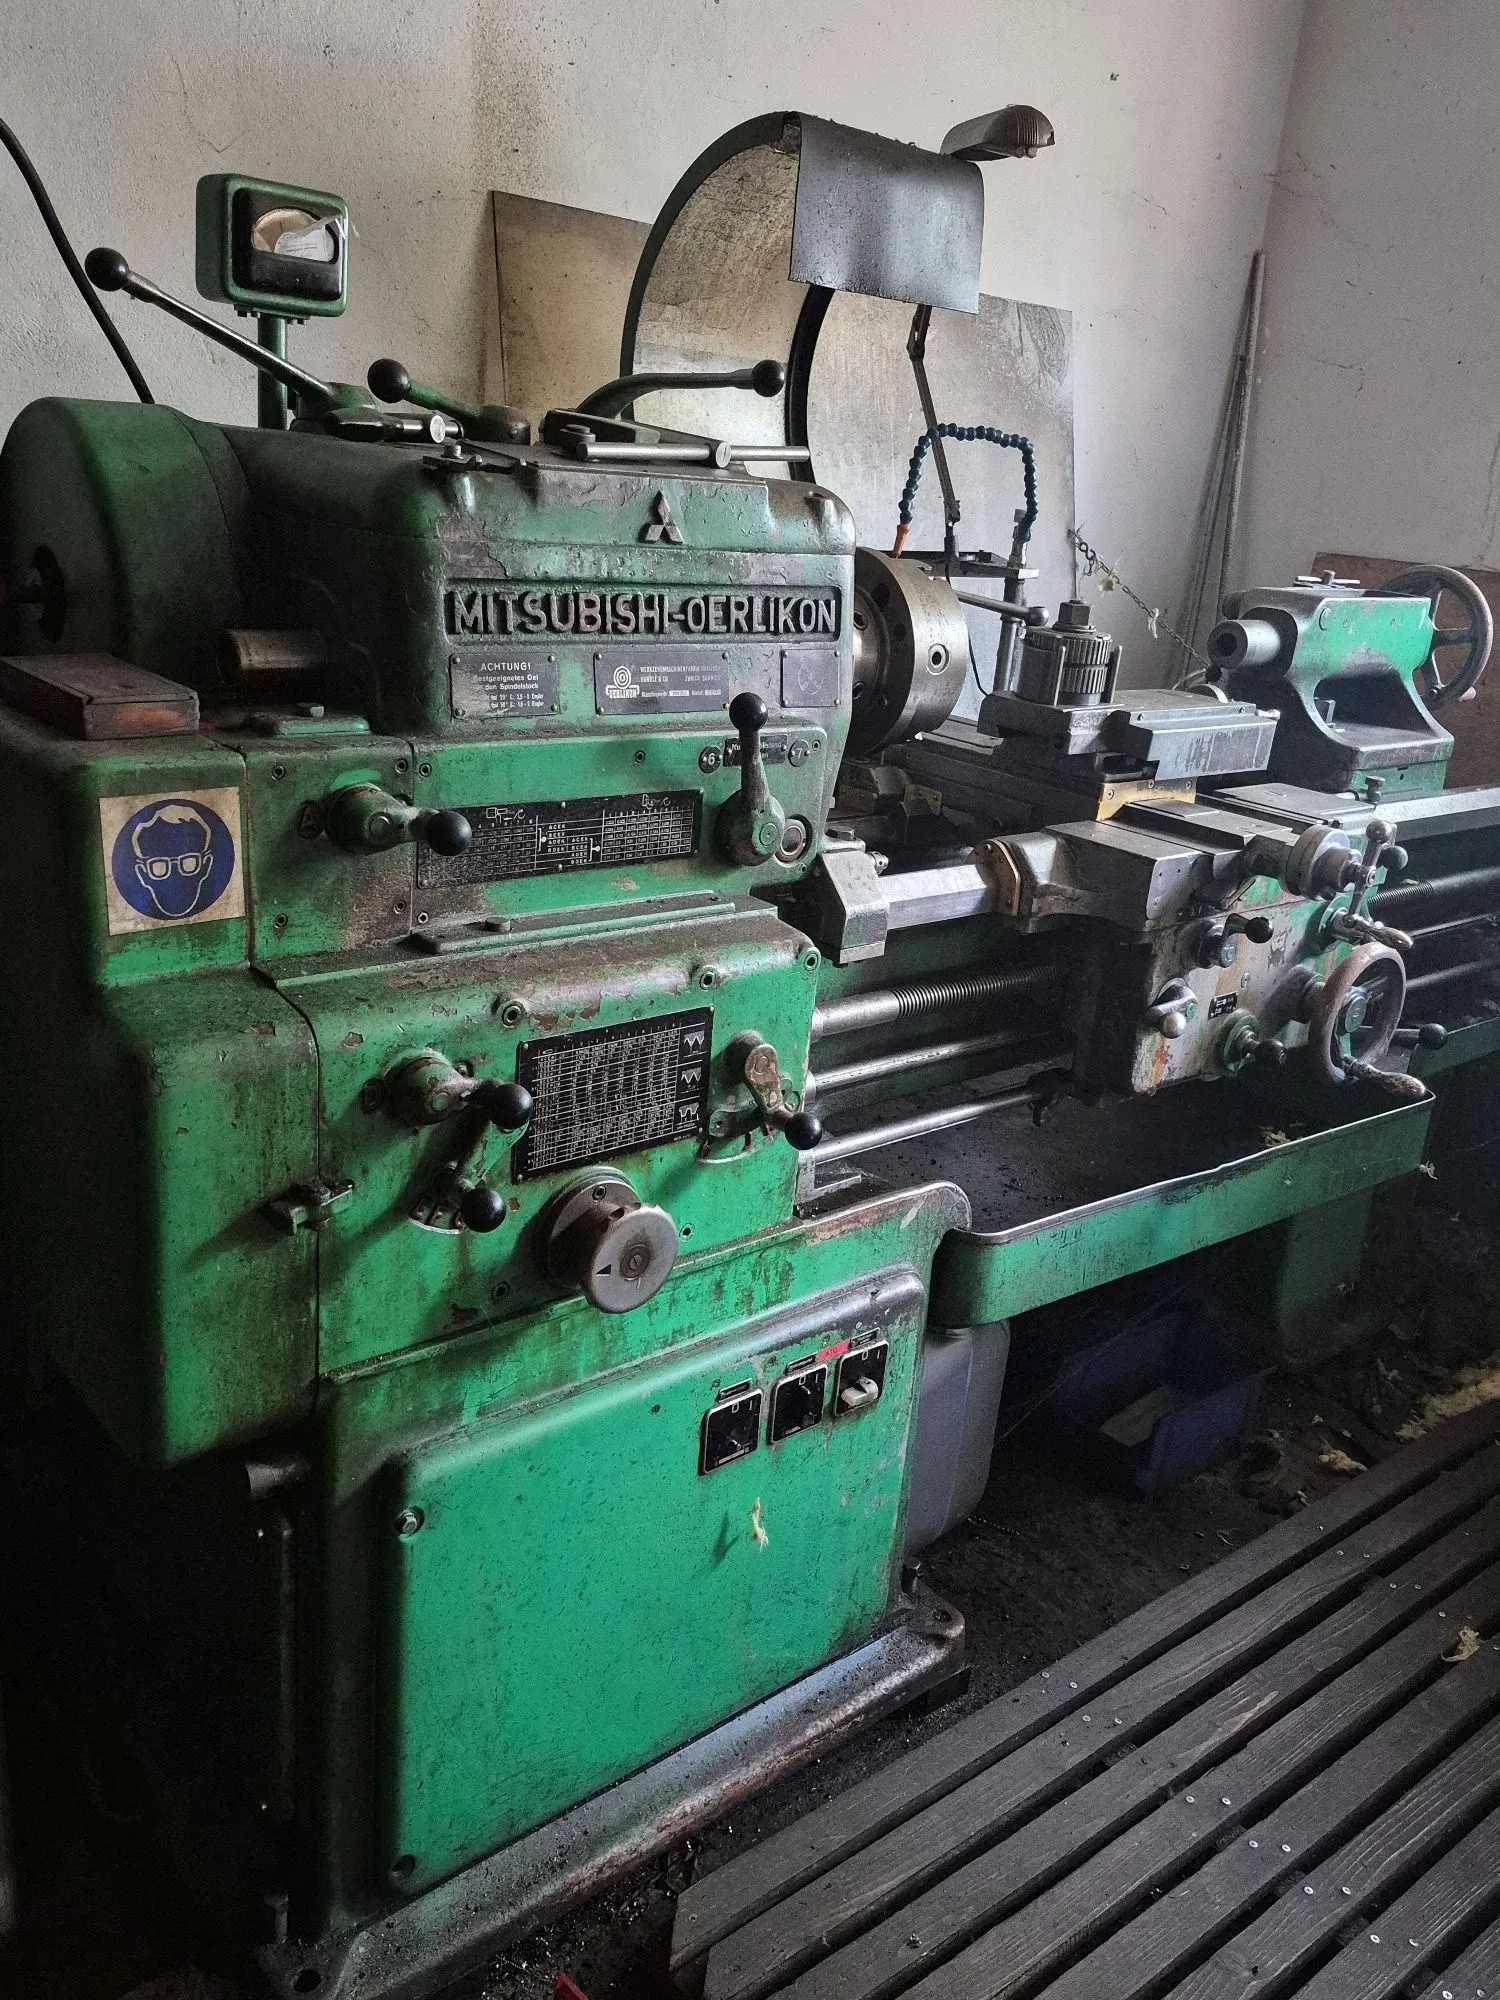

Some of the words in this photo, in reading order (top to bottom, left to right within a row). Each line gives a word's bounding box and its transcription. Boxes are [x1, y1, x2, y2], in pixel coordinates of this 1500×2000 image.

[453, 590, 837, 635] MITSUBISHI-OERLIKON
[480, 662, 531, 671] ACHTUNG!
[500, 683, 539, 691] Spindelstock
[708, 753, 715, 765] 6
[797, 748, 803, 759] 7
